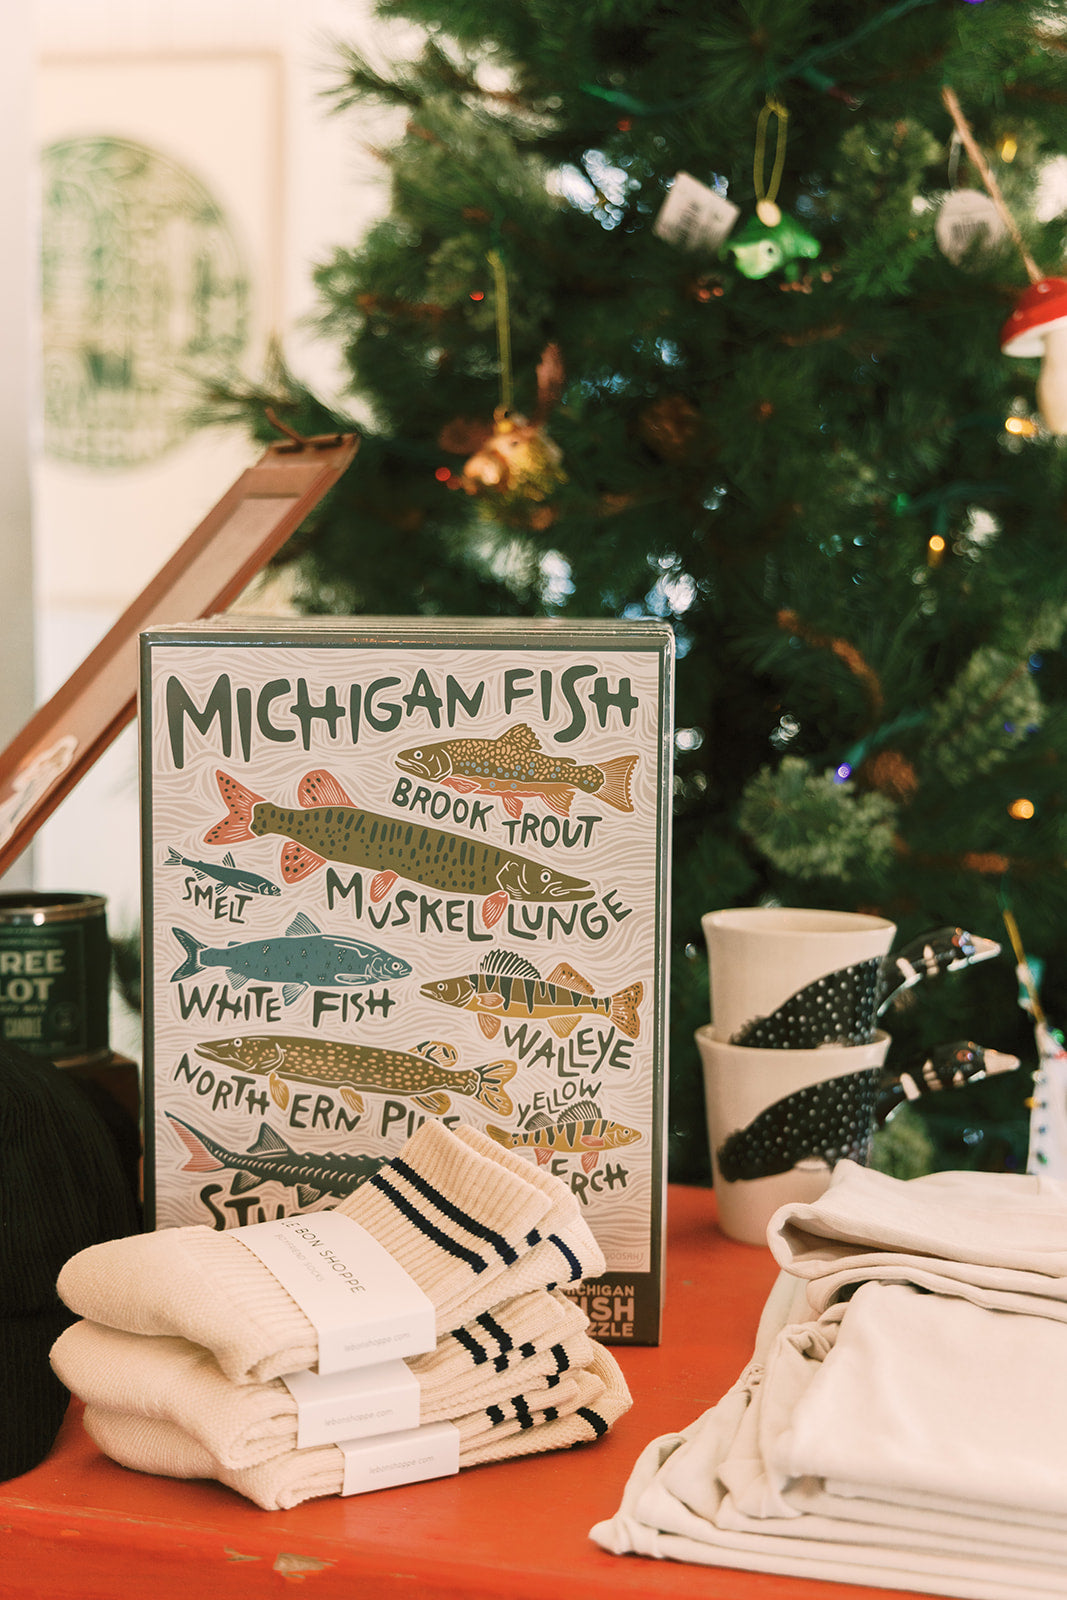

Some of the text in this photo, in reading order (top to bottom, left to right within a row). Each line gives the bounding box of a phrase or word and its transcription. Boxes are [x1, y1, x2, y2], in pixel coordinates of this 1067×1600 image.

[165, 664, 640, 770] MICHIGAN FISH
[391, 776, 604, 849] BROOK TROUT
[182, 876, 254, 924] SMELT
[0, 949, 66, 975] REE
[177, 983, 397, 1028] WHITE FISH
[504, 1024, 635, 1078] WALLEYE
[380, 1100, 461, 1139] PIE
[516, 1079, 603, 1128] YELLOW
[550, 1158, 630, 1206] ERCH
[295, 1227, 325, 1248] BON
[319, 1249, 367, 1294] SHOPPE
[565, 1284, 635, 1297] ICHIGAN
[585, 1322, 635, 1337] ZZLE
